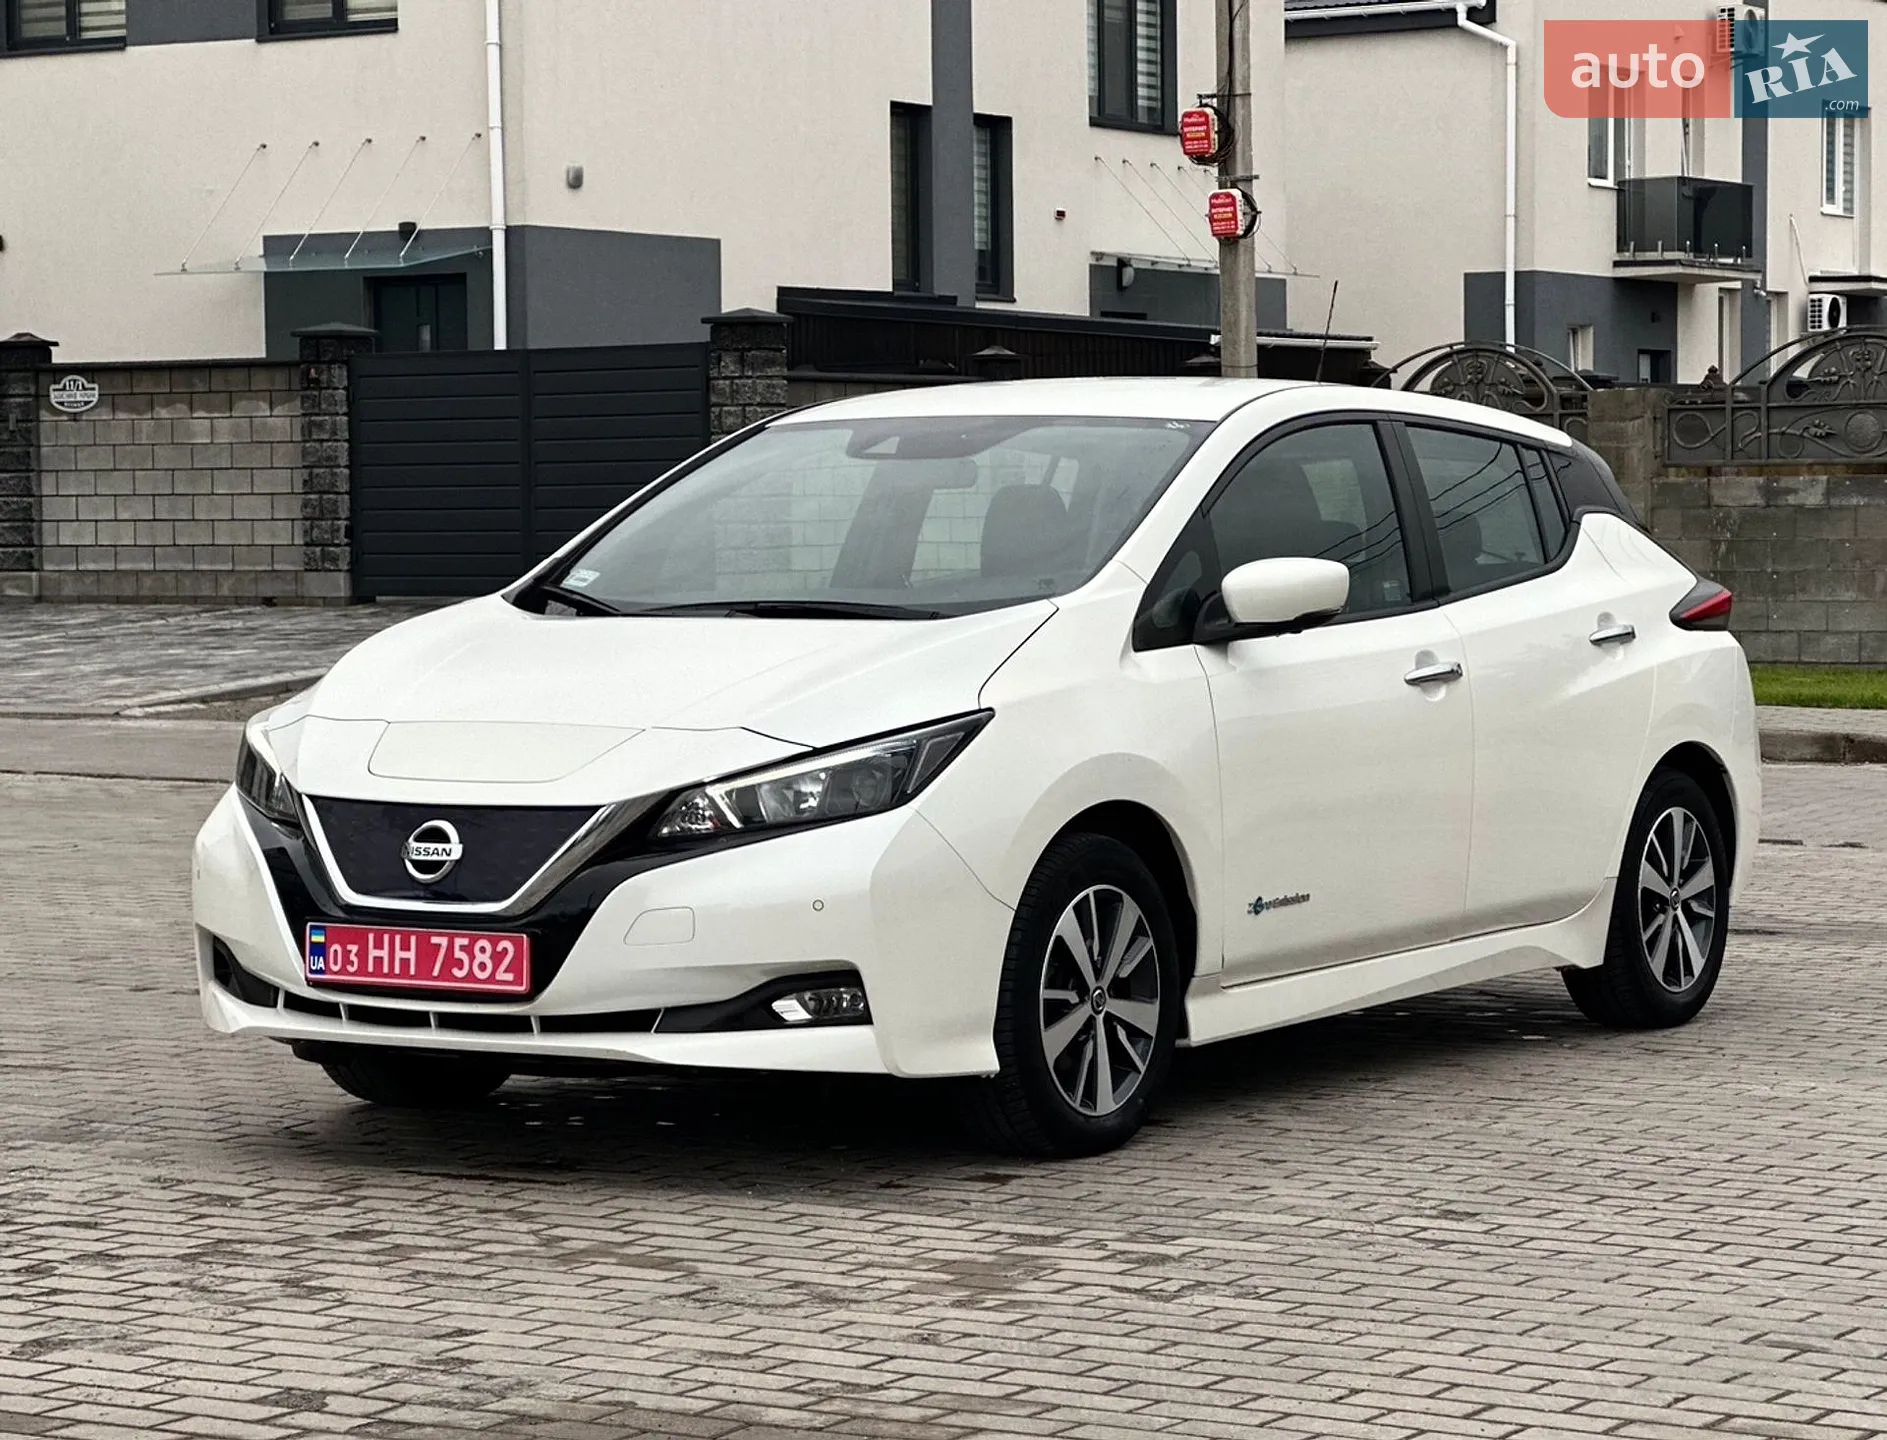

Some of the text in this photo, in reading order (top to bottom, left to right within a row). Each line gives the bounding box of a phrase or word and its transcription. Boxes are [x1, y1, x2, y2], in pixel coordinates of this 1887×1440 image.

[310, 955, 325, 971] UA
[329, 933, 515, 982] 03 HH 7582
